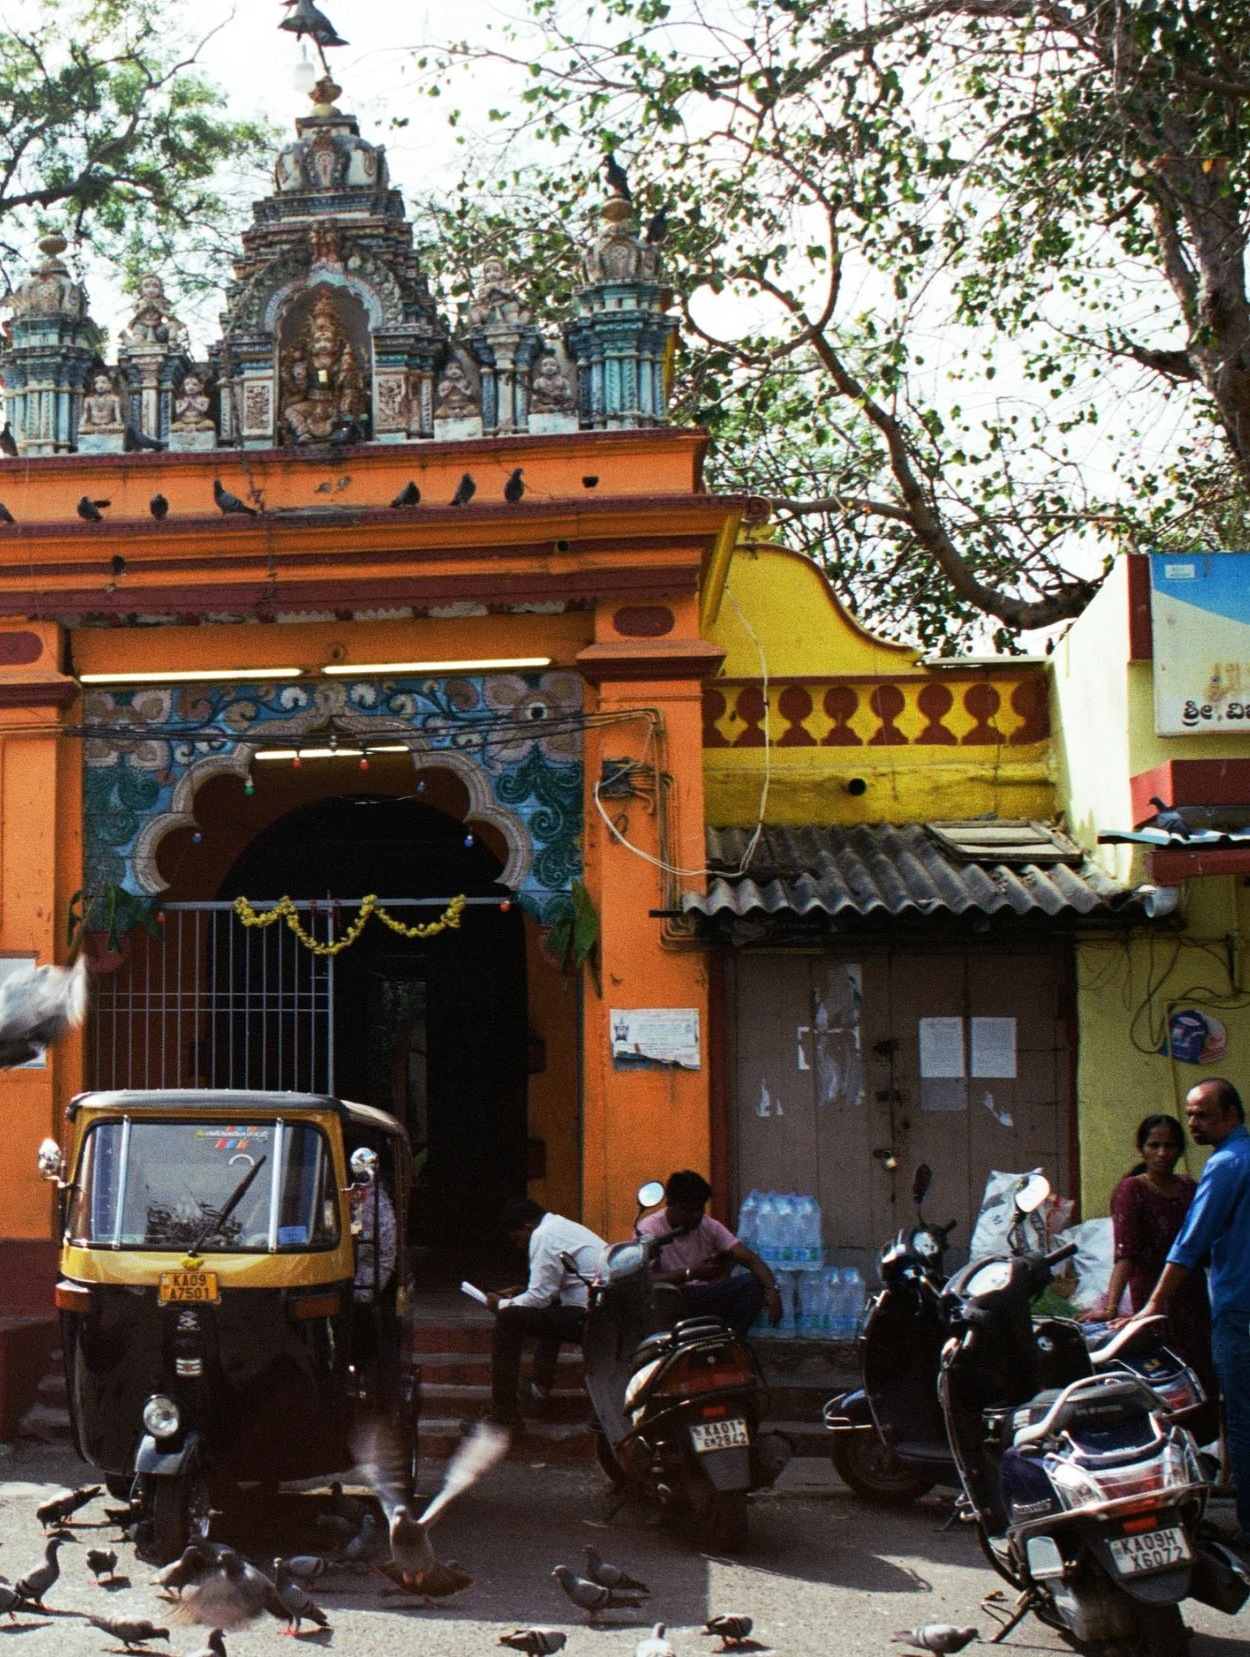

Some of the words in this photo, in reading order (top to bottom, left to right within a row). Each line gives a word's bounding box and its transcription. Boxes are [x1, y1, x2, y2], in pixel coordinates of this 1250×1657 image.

[173, 1274, 206, 1286] KA09
[170, 1287, 210, 1299] A7501
[703, 1421, 736, 1436] KA01
[1120, 1529, 1177, 1555] KA09H
[1130, 1545, 1183, 1570] X6072
